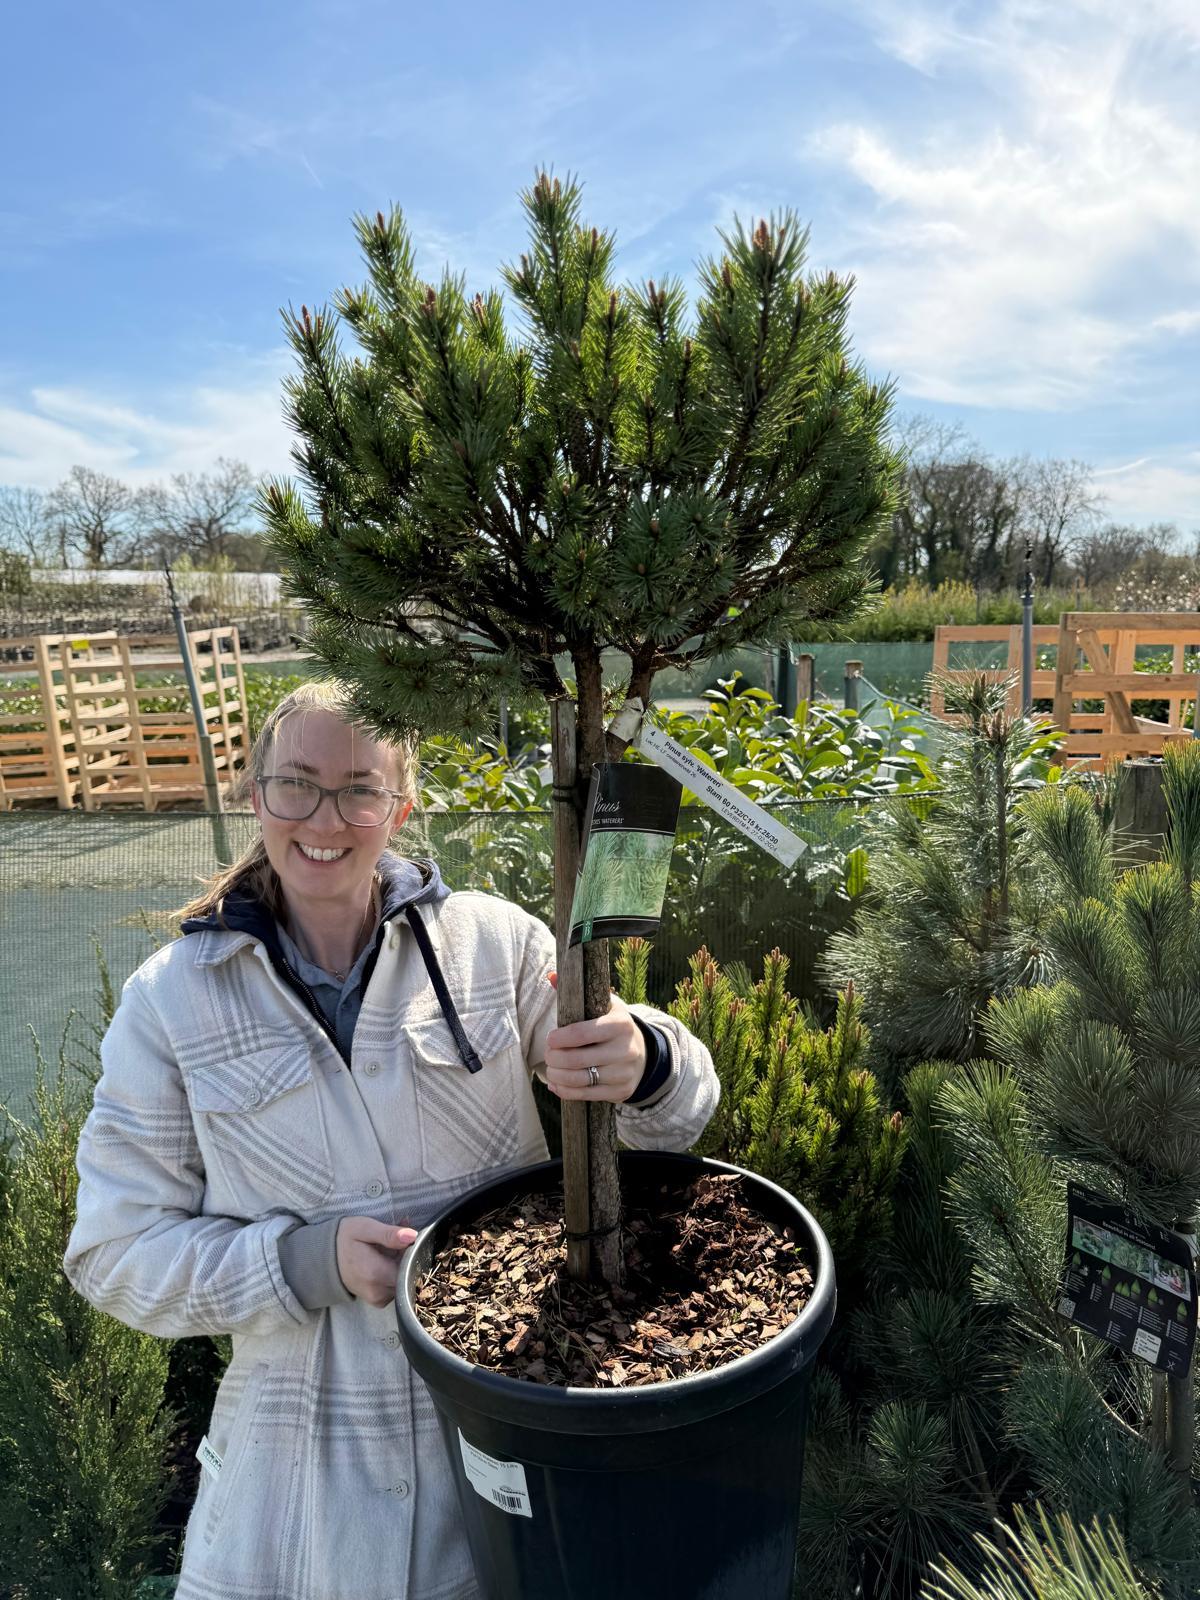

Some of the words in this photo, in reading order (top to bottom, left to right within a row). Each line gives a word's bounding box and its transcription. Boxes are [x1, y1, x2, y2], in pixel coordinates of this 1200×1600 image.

[664, 741, 682, 757] Pinus
[680, 754, 696, 768] sylv.
[705, 785, 723, 801] Stam
[730, 804, 756, 826] P32/C15
